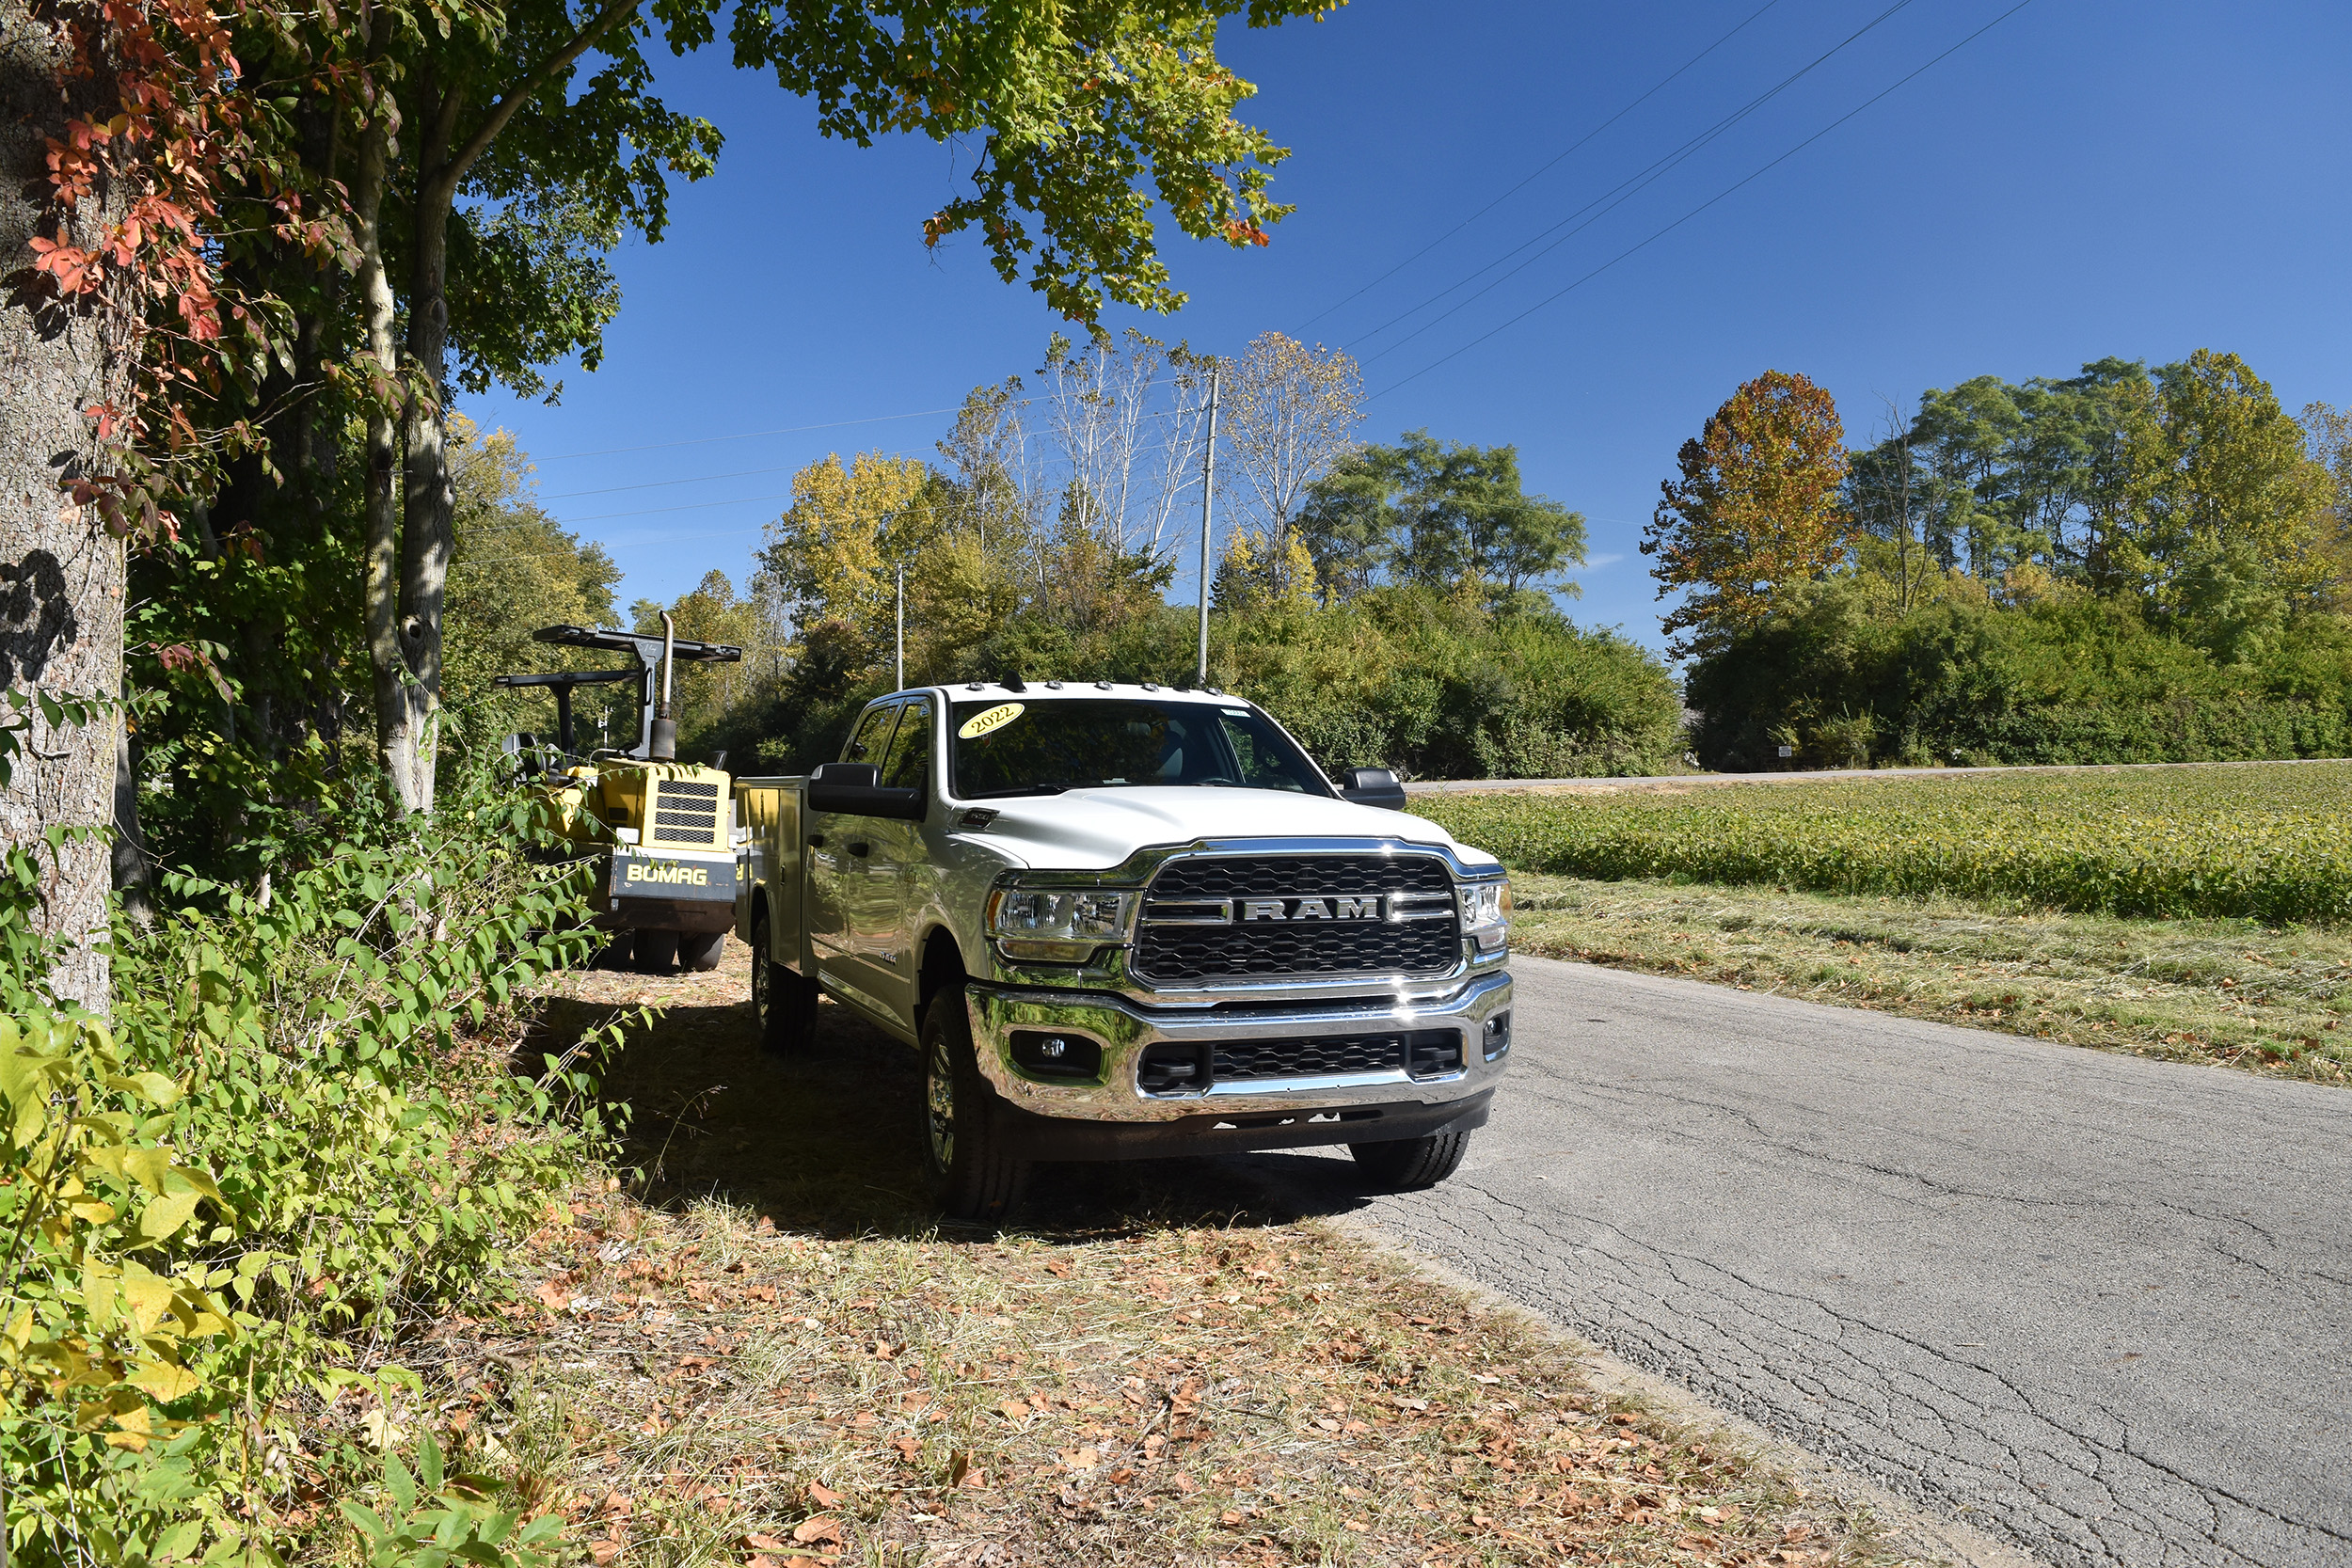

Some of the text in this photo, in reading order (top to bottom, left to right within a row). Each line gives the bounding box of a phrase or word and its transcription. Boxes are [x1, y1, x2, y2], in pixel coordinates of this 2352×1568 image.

[971, 706, 1014, 733] 2022
[627, 863, 707, 886] BOMAG
[1244, 896, 1380, 921] RAM
